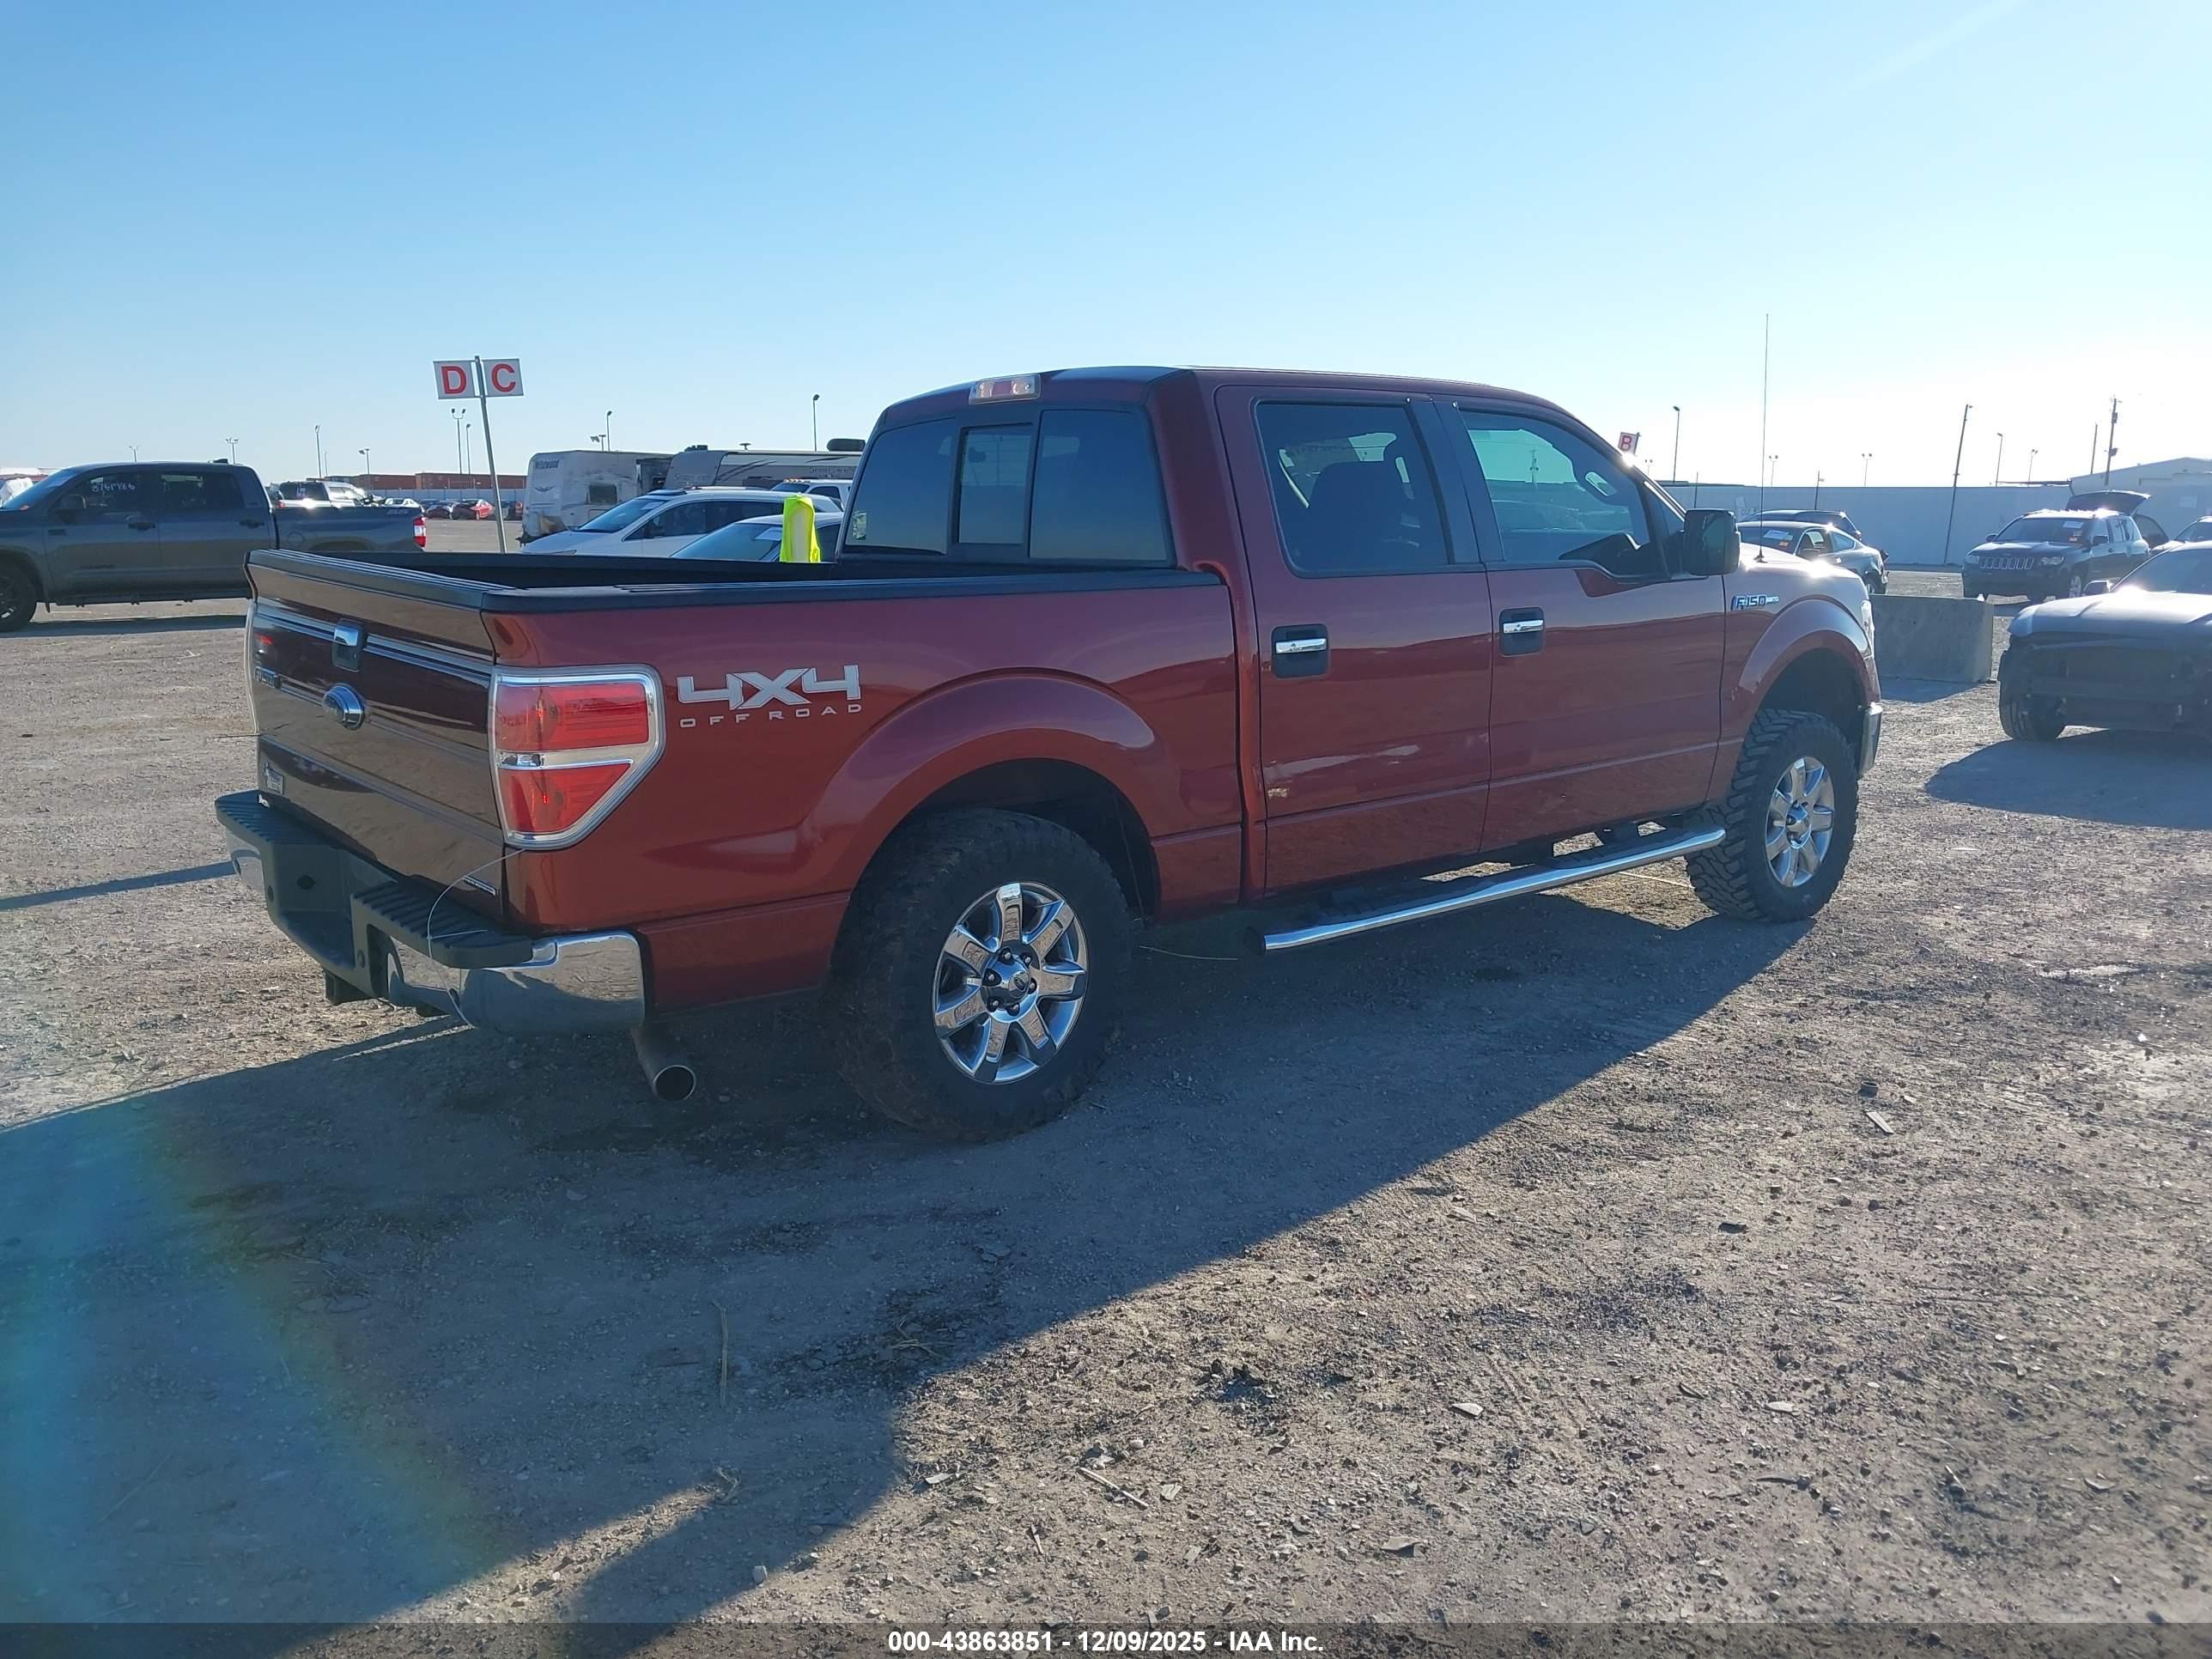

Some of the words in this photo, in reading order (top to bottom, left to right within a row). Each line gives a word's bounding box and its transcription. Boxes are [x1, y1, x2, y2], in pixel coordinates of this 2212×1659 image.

[441, 365, 467, 394] D
[490, 363, 516, 392] C
[1620, 434, 1632, 451] B
[679, 715, 750, 728] OFF
[769, 703, 862, 720] ROAD
